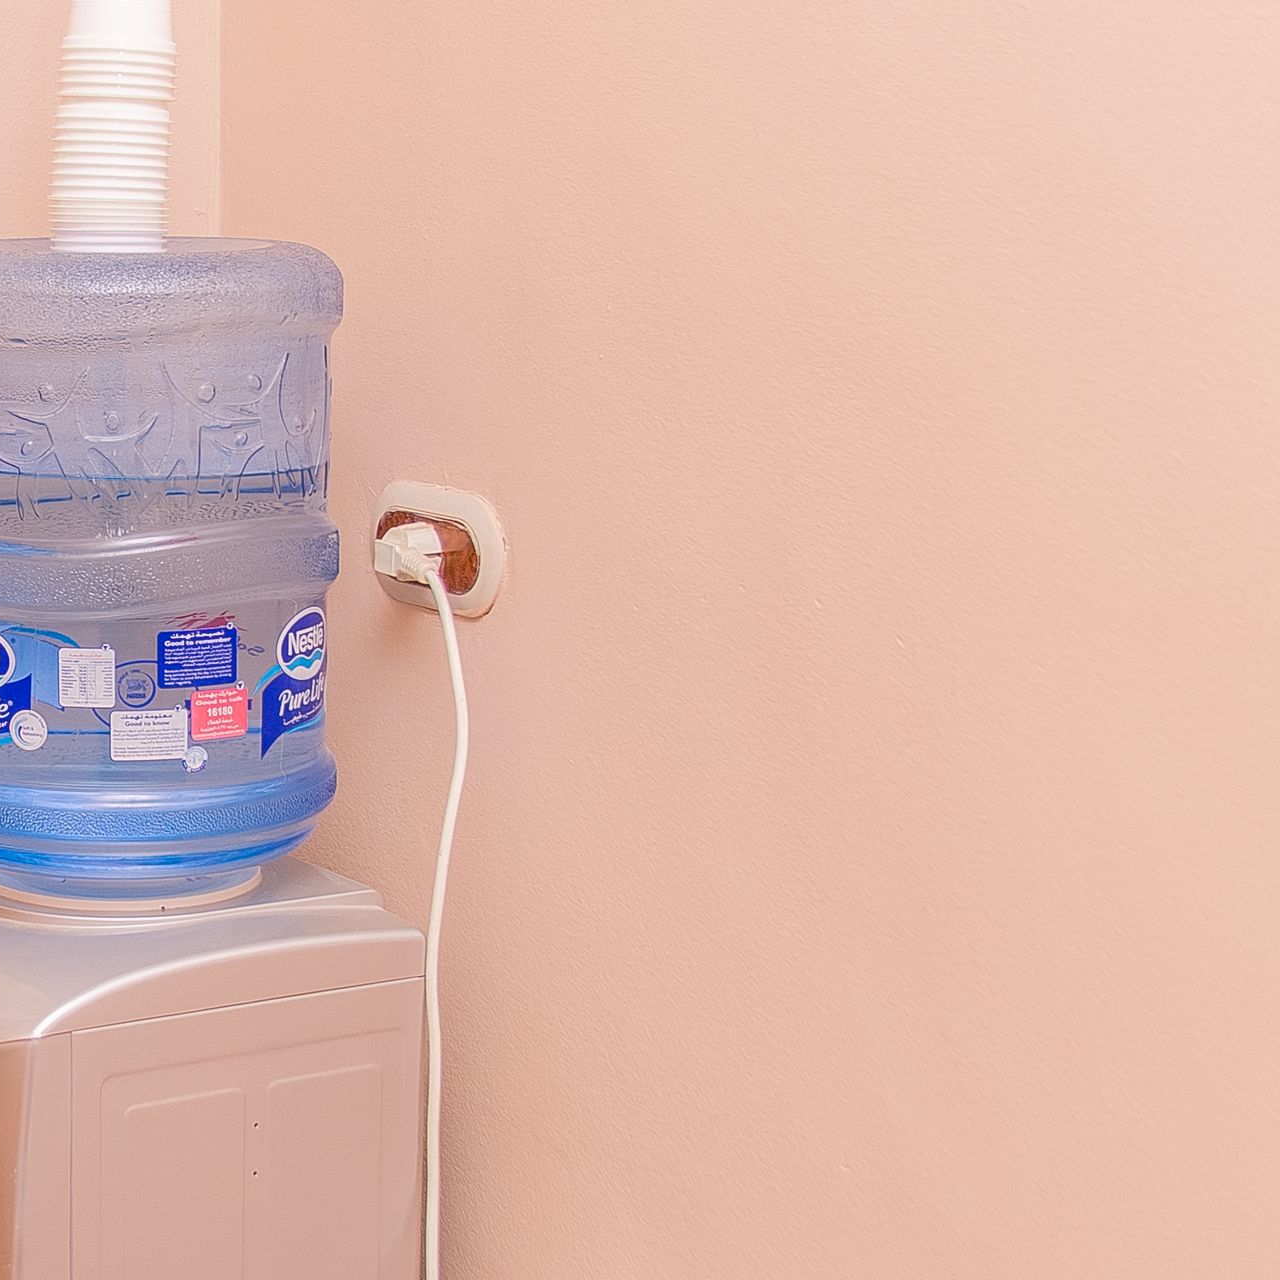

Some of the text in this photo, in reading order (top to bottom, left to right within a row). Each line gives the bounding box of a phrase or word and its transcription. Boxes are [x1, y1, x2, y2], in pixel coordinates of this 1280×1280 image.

[164, 639, 185, 647] Good
[195, 636, 232, 645] remember
[278, 689, 310, 716] Pure
[206, 705, 233, 717] 16180
